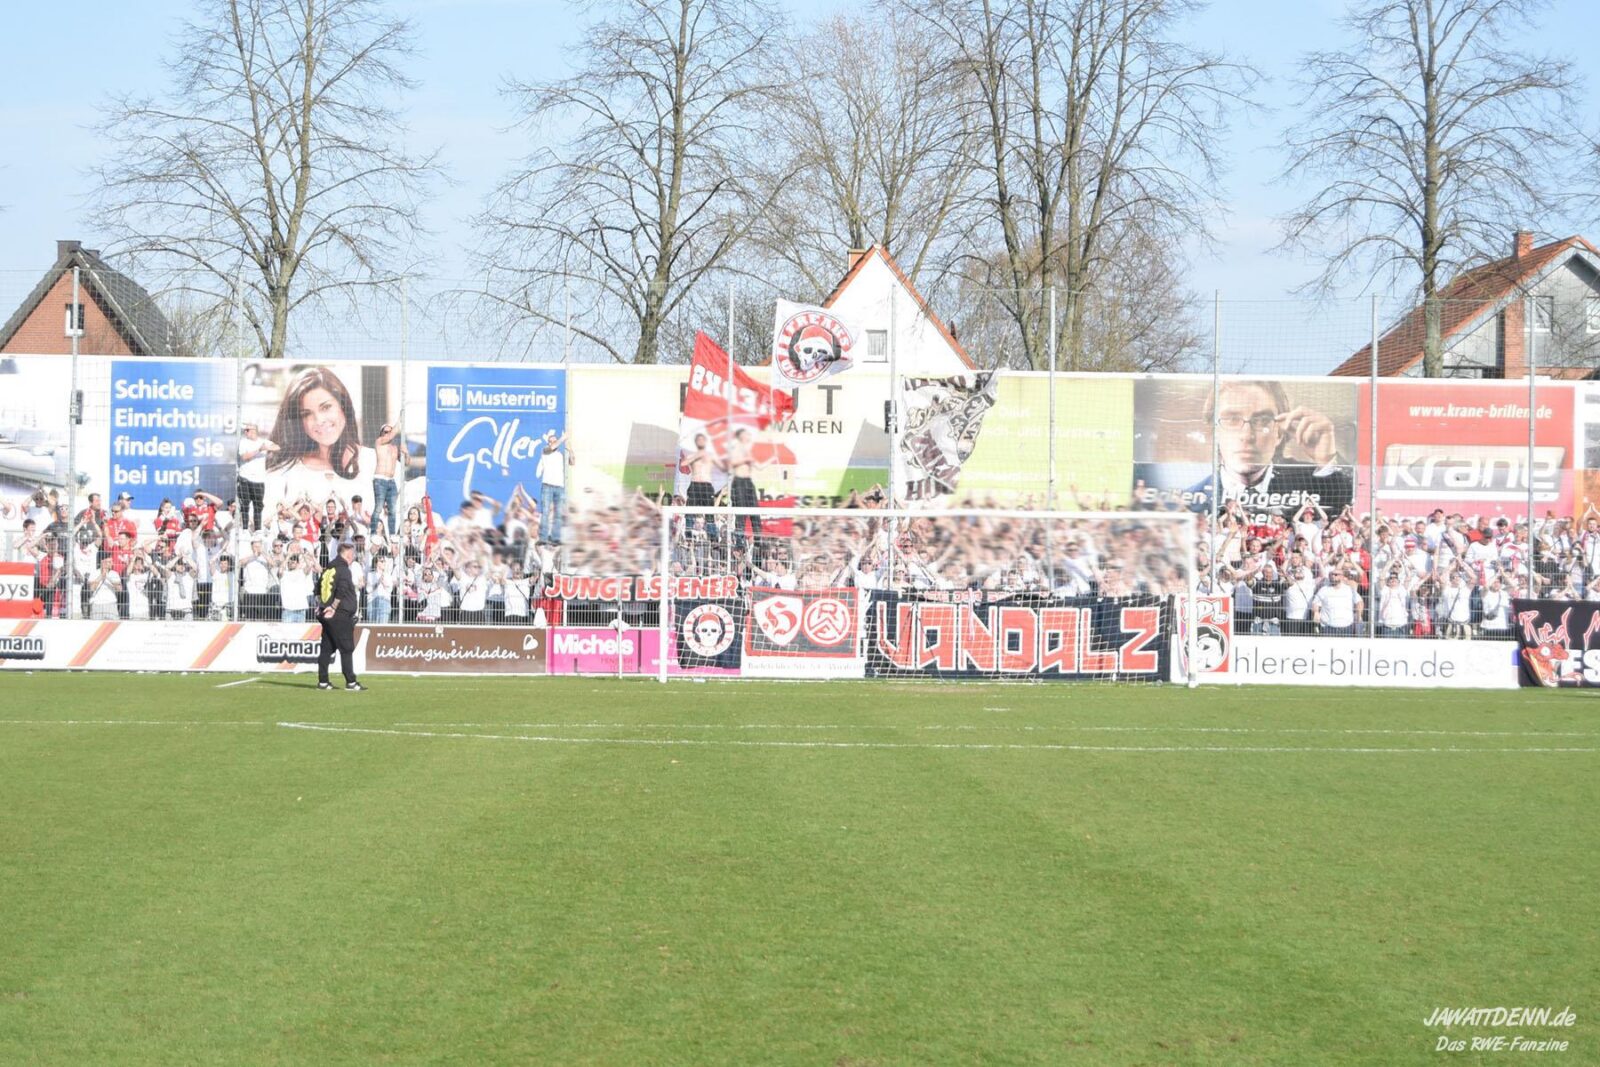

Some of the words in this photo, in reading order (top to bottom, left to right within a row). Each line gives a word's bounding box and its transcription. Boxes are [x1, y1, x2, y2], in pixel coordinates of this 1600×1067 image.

[114, 379, 194, 400] Schicke
[466, 390, 558, 410] Musterring
[115, 407, 238, 434] Einrichtung
[1409, 403, 1553, 419] www.krane-brillende
[114, 435, 185, 457] finden
[192, 437, 224, 457] Sie
[114, 464, 147, 484] bei
[155, 466, 200, 486] uns!
[1384, 454, 1556, 489] krane
[1221, 489, 1320, 508] Hörgeräte
[546, 574, 632, 600] JUNGE
[876, 601, 1161, 674] VANDALZ
[1518, 606, 1573, 651] Red
[375, 644, 520, 662] lieblingsweinladen
[553, 633, 634, 657] Michels
